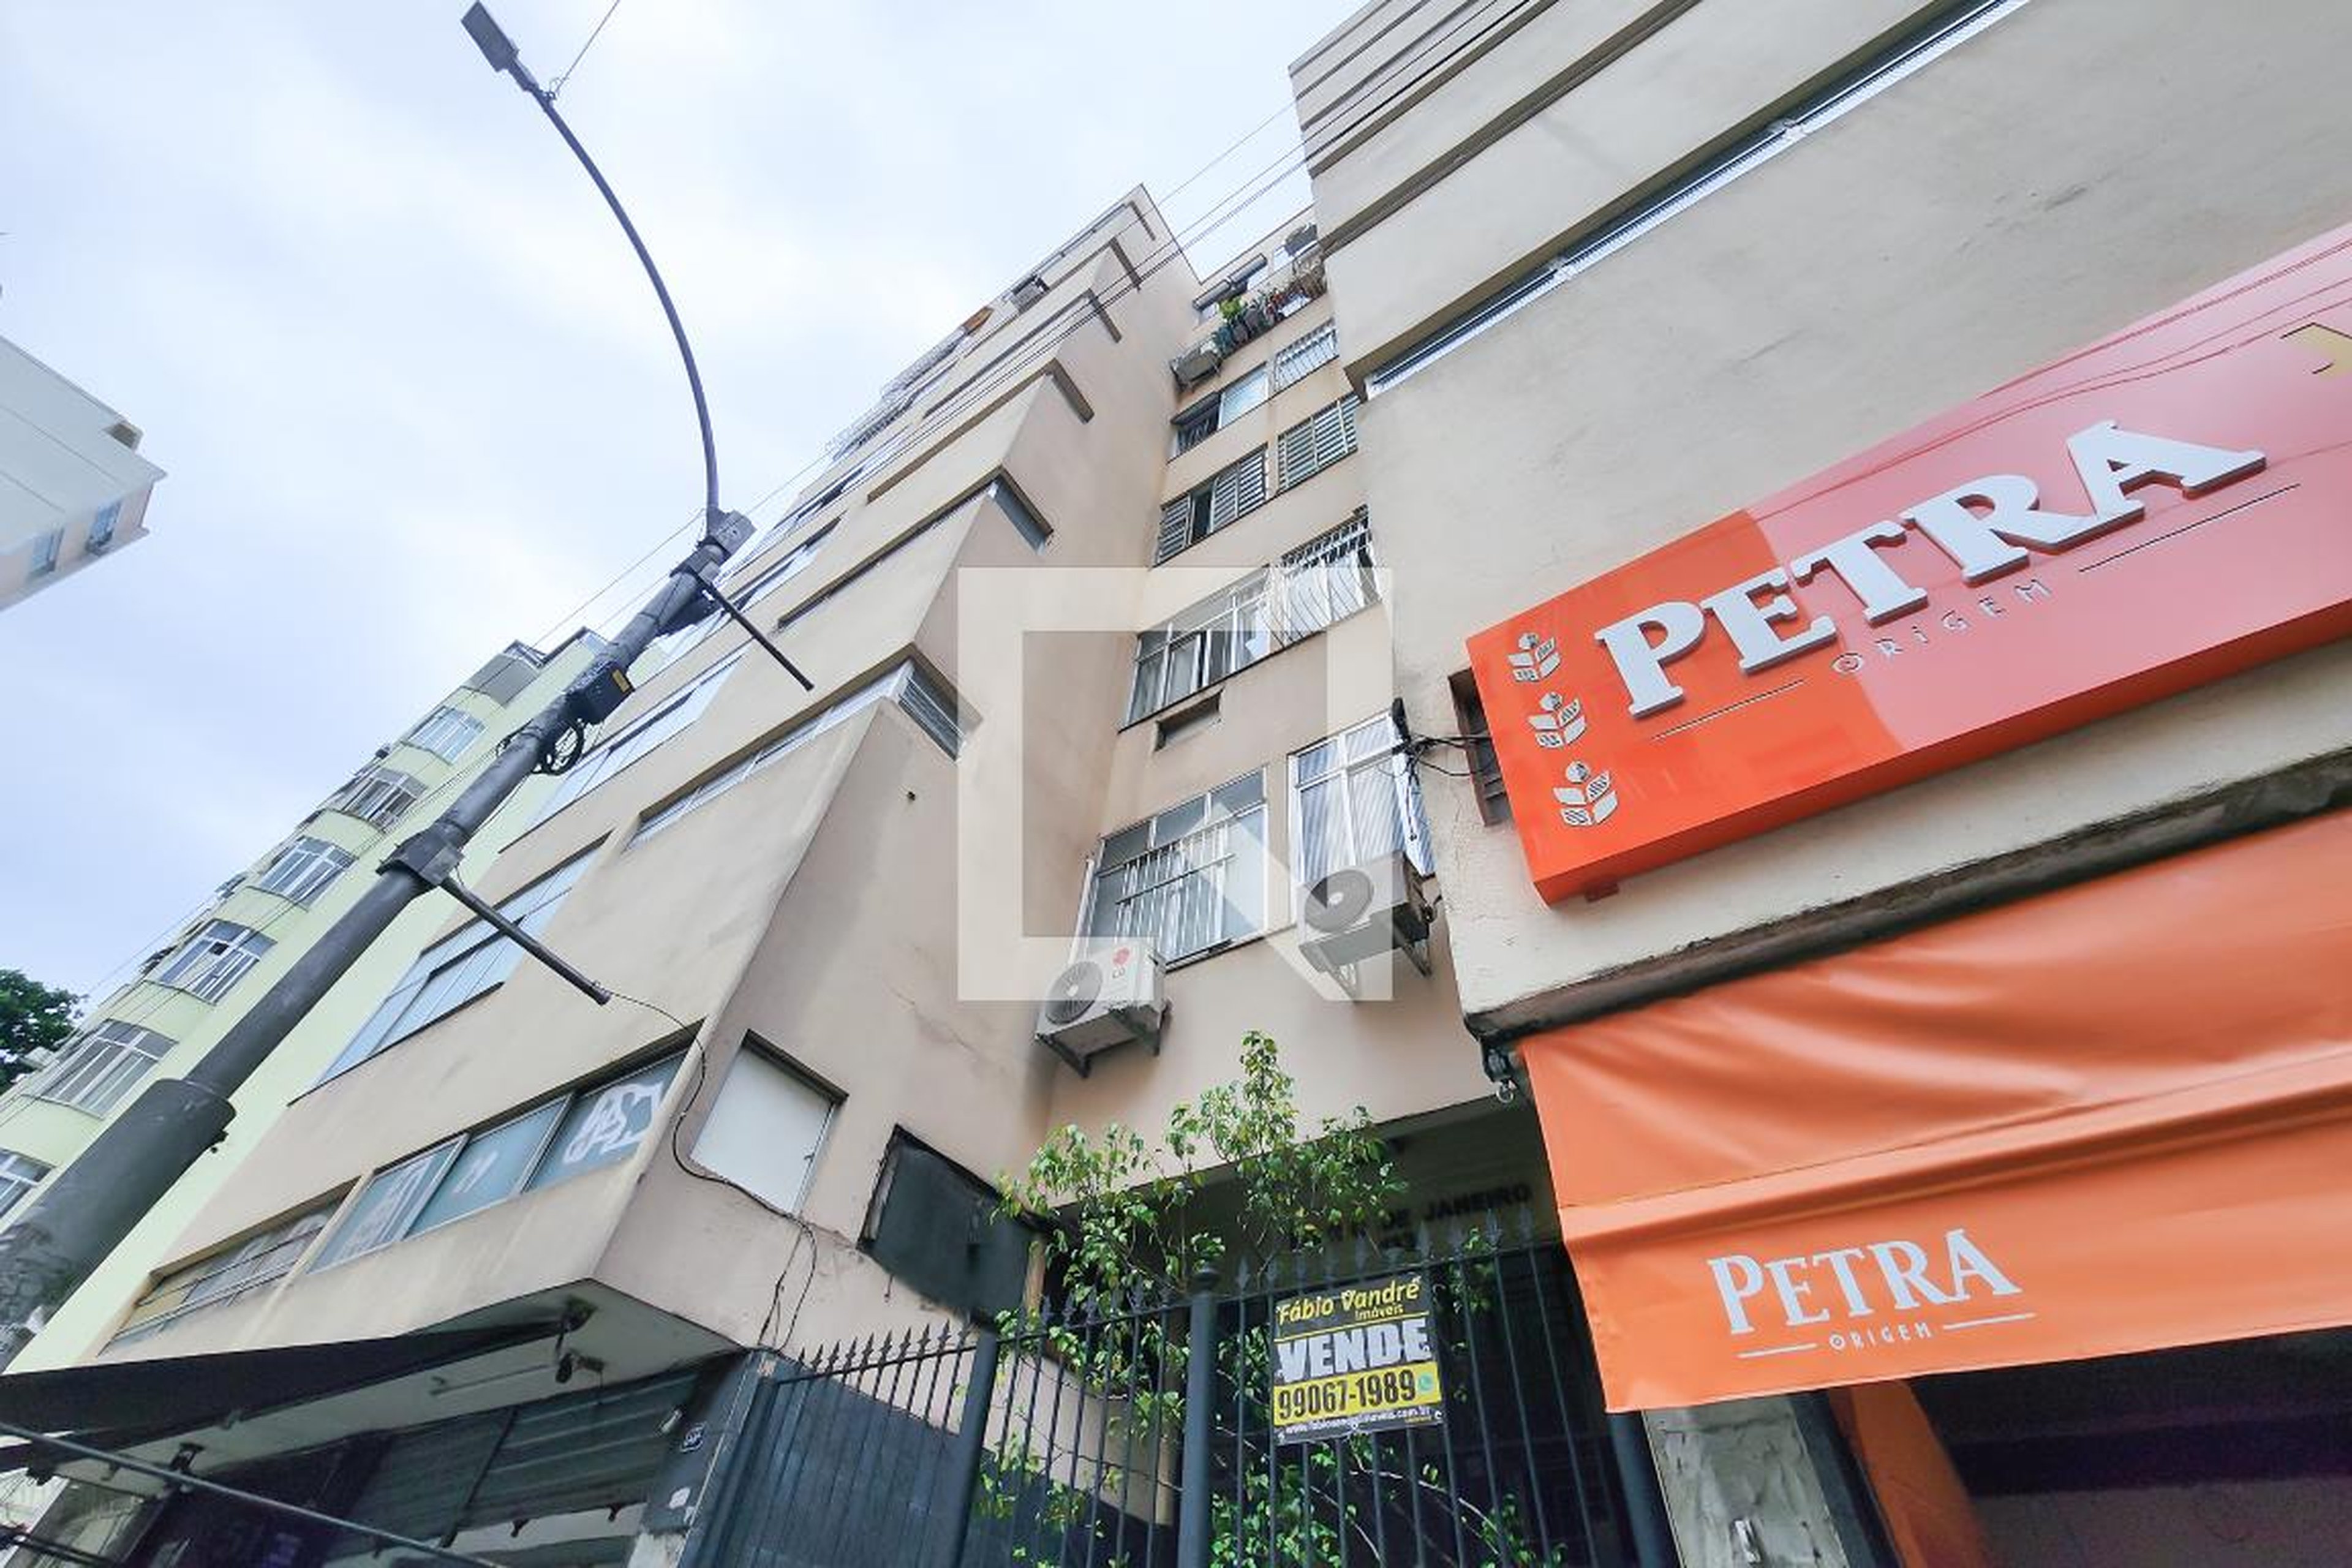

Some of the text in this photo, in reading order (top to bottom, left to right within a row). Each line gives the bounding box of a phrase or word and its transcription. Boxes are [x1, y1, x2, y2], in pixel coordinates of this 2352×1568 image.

[1594, 420, 2267, 719] PETRA
[1831, 579, 2051, 674] ORIGEM
[1278, 1295, 1334, 1325] Fábio
[1707, 1228, 2022, 1335] PETRA
[1277, 1317, 1432, 1383] VENDE
[1830, 1322, 1932, 1350] ORIGEM
[1278, 1368, 1417, 1420] 99067-1989
